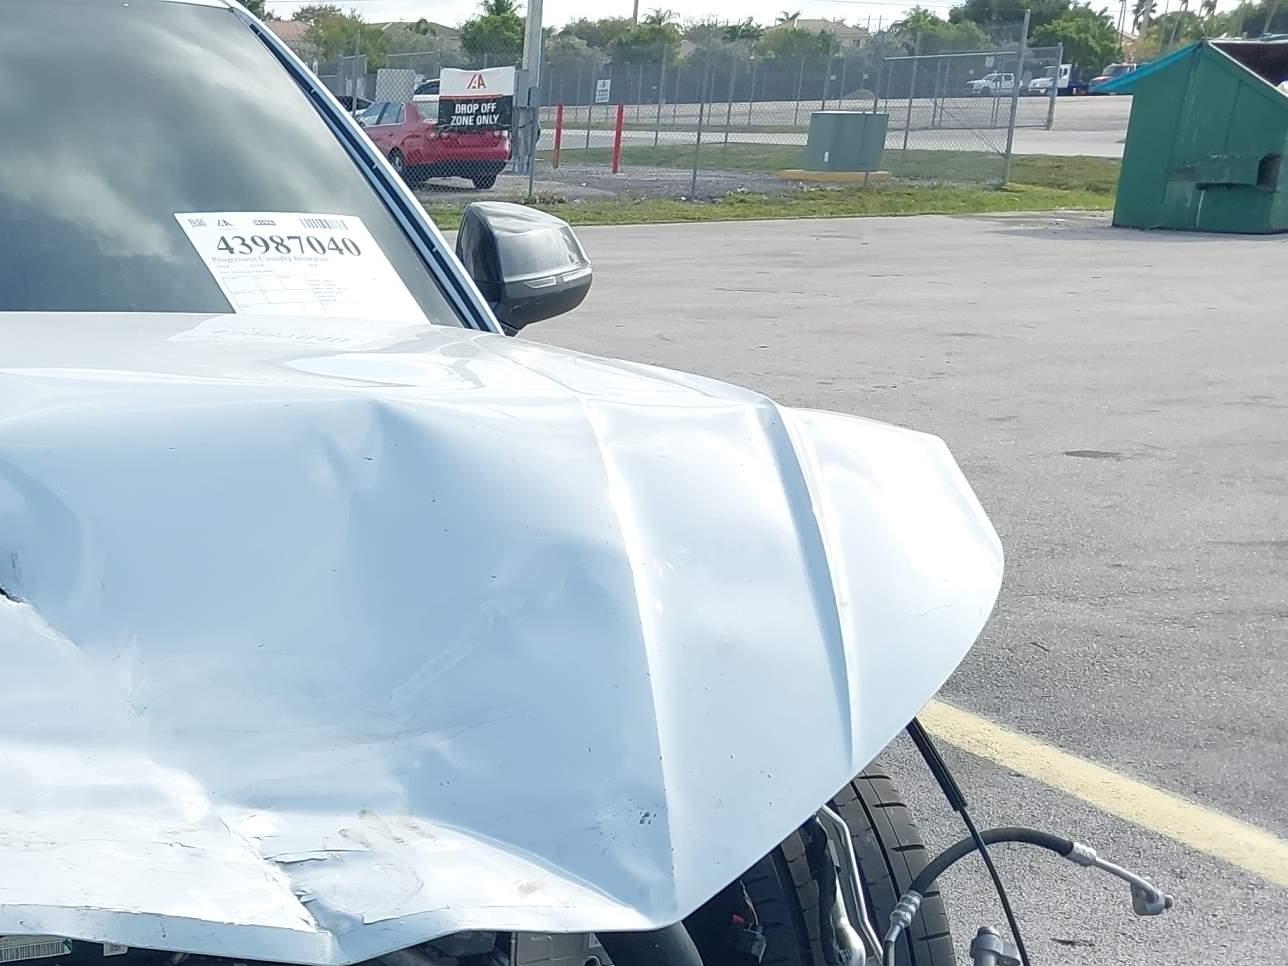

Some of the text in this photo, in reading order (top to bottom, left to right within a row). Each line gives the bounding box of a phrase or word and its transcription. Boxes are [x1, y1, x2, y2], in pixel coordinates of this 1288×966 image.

[454, 102, 497, 114] DROP OFF
[450, 114, 500, 126] ZONE ONLY
[216, 234, 362, 257] 43987040
